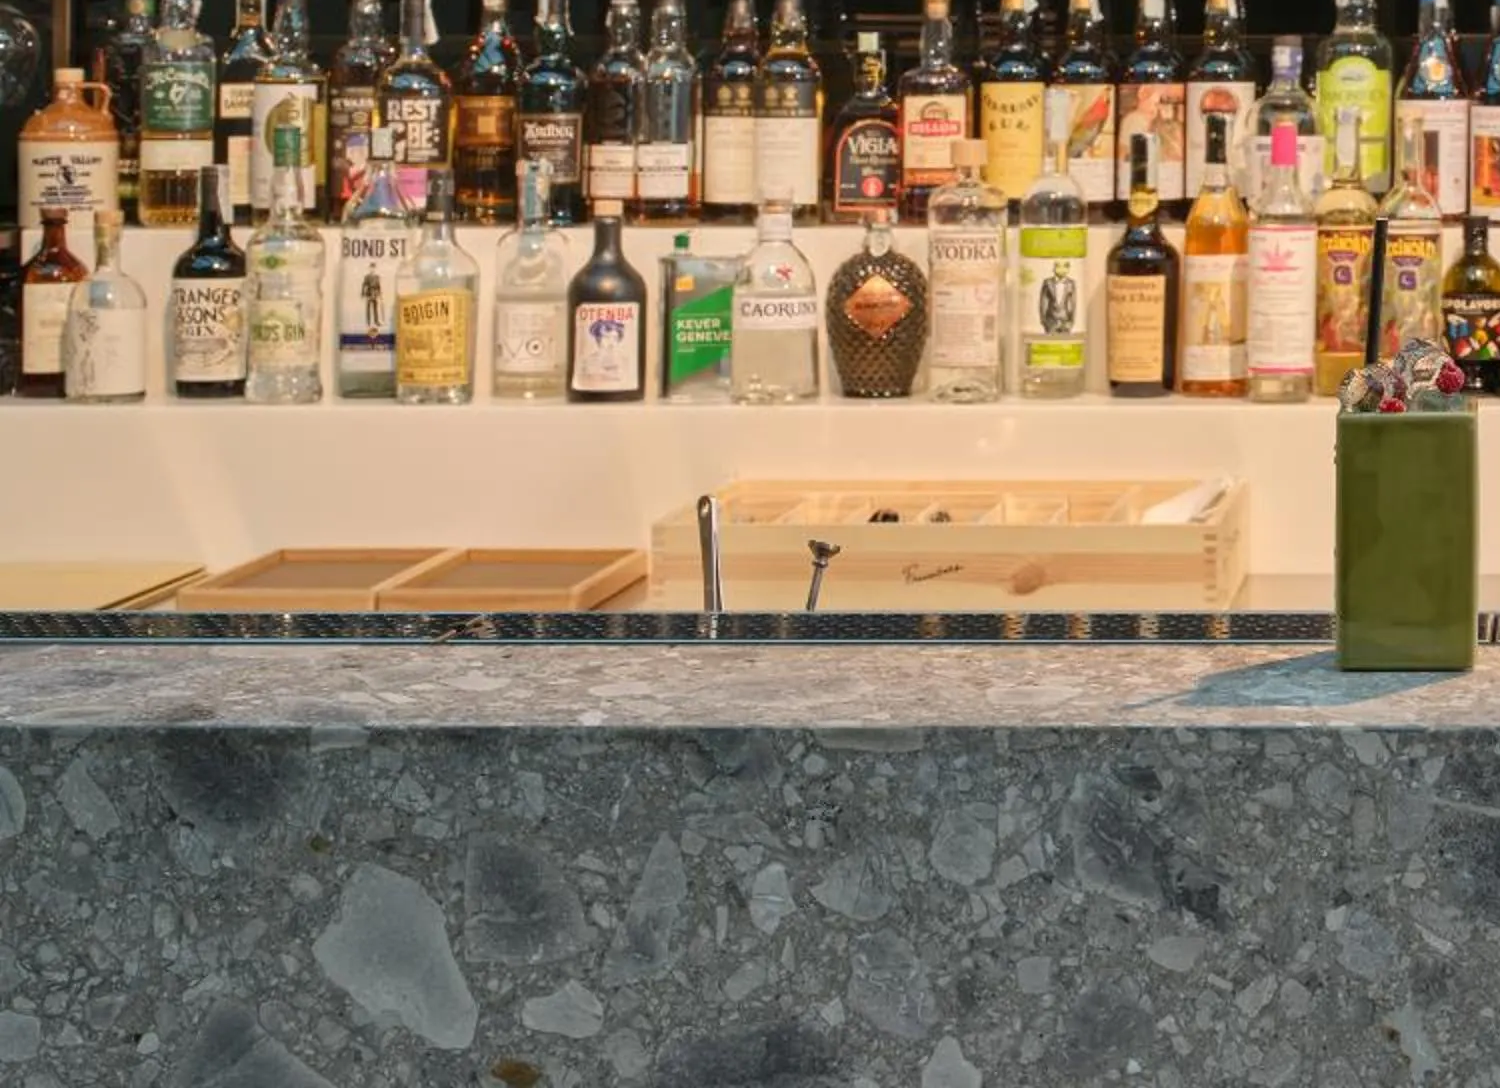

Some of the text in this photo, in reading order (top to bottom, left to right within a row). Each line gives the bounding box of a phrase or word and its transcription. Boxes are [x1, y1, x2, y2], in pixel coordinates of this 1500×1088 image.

[386, 98, 443, 122] REST
[342, 237, 408, 258] BOND ST
[935, 245, 998, 260] VODKA
[172, 287, 241, 306] TRANGER
[676, 318, 721, 330] KEVER
[676, 331, 732, 342] GENEVE
